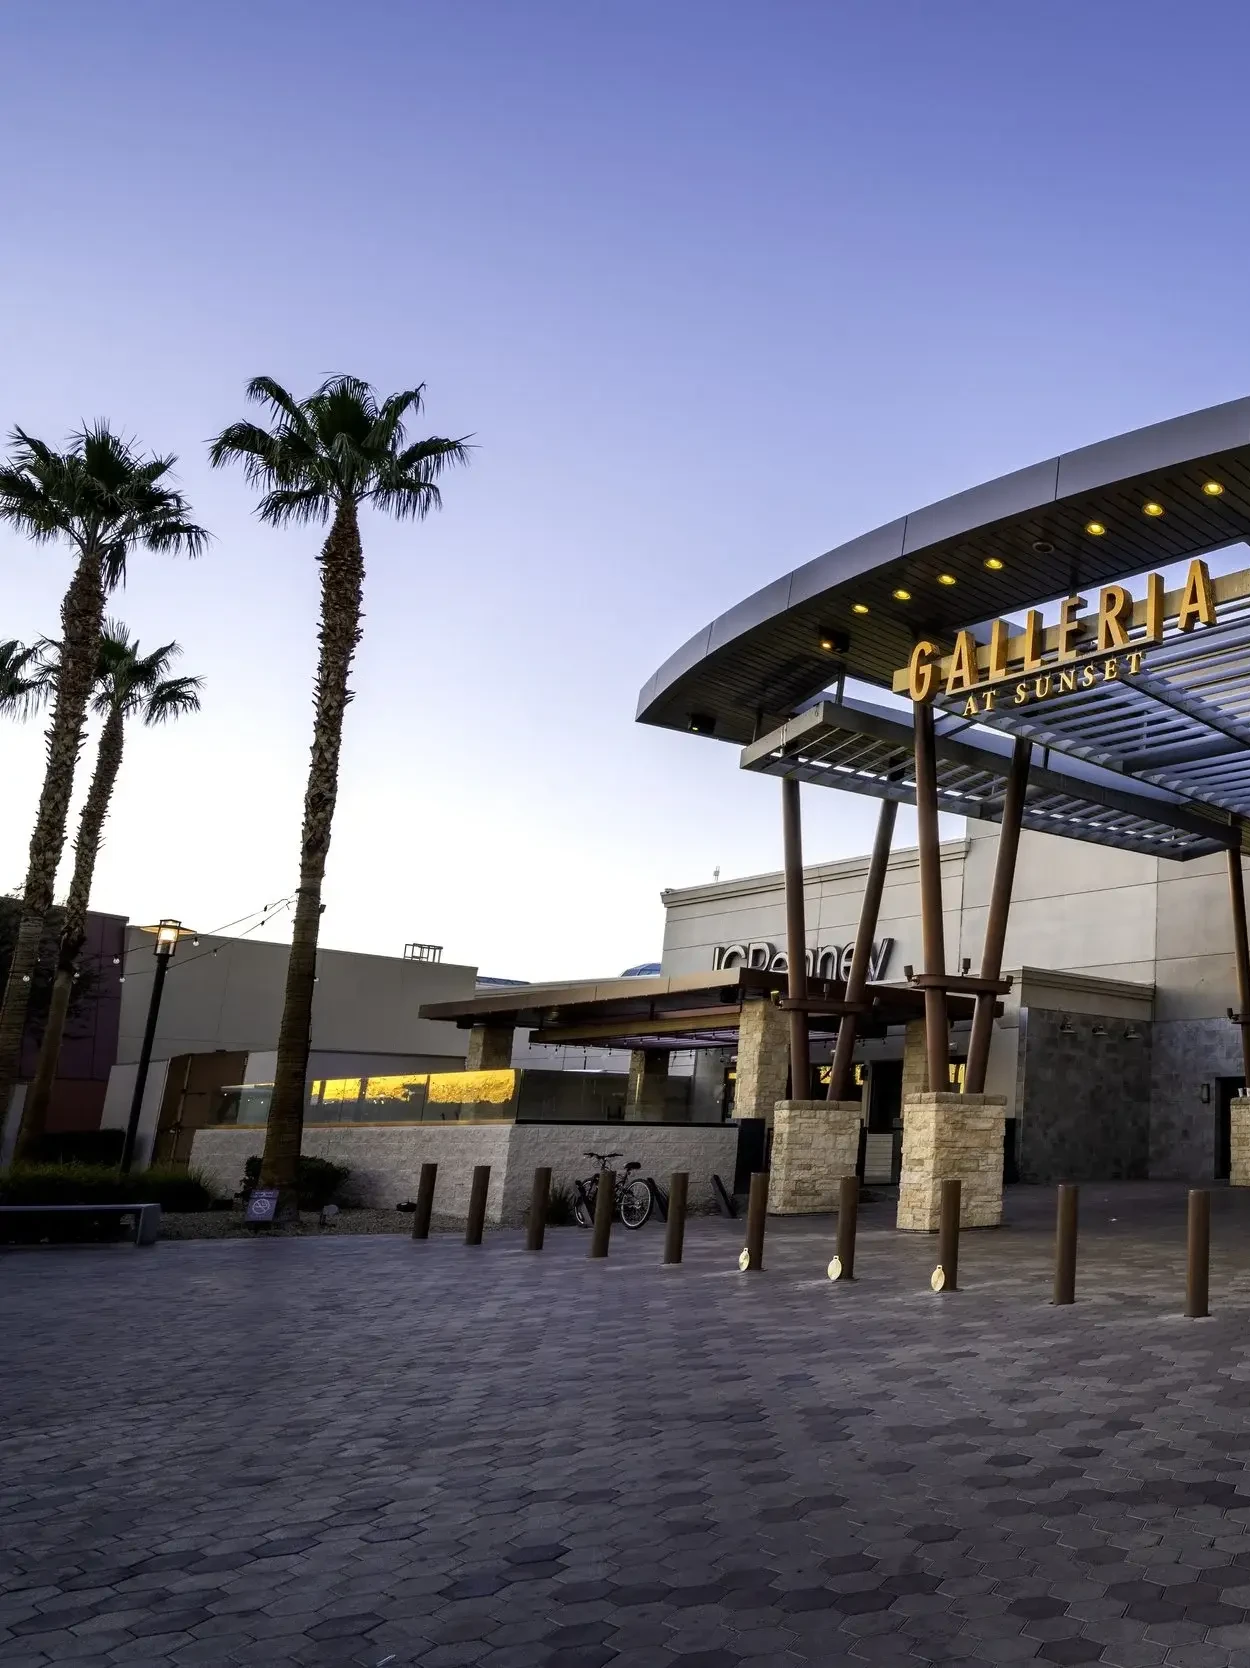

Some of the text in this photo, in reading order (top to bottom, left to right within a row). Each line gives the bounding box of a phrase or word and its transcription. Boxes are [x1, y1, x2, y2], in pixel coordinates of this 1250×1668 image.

[908, 559, 1217, 702] GALLERIA
[963, 650, 1144, 716] AT SUNSET
